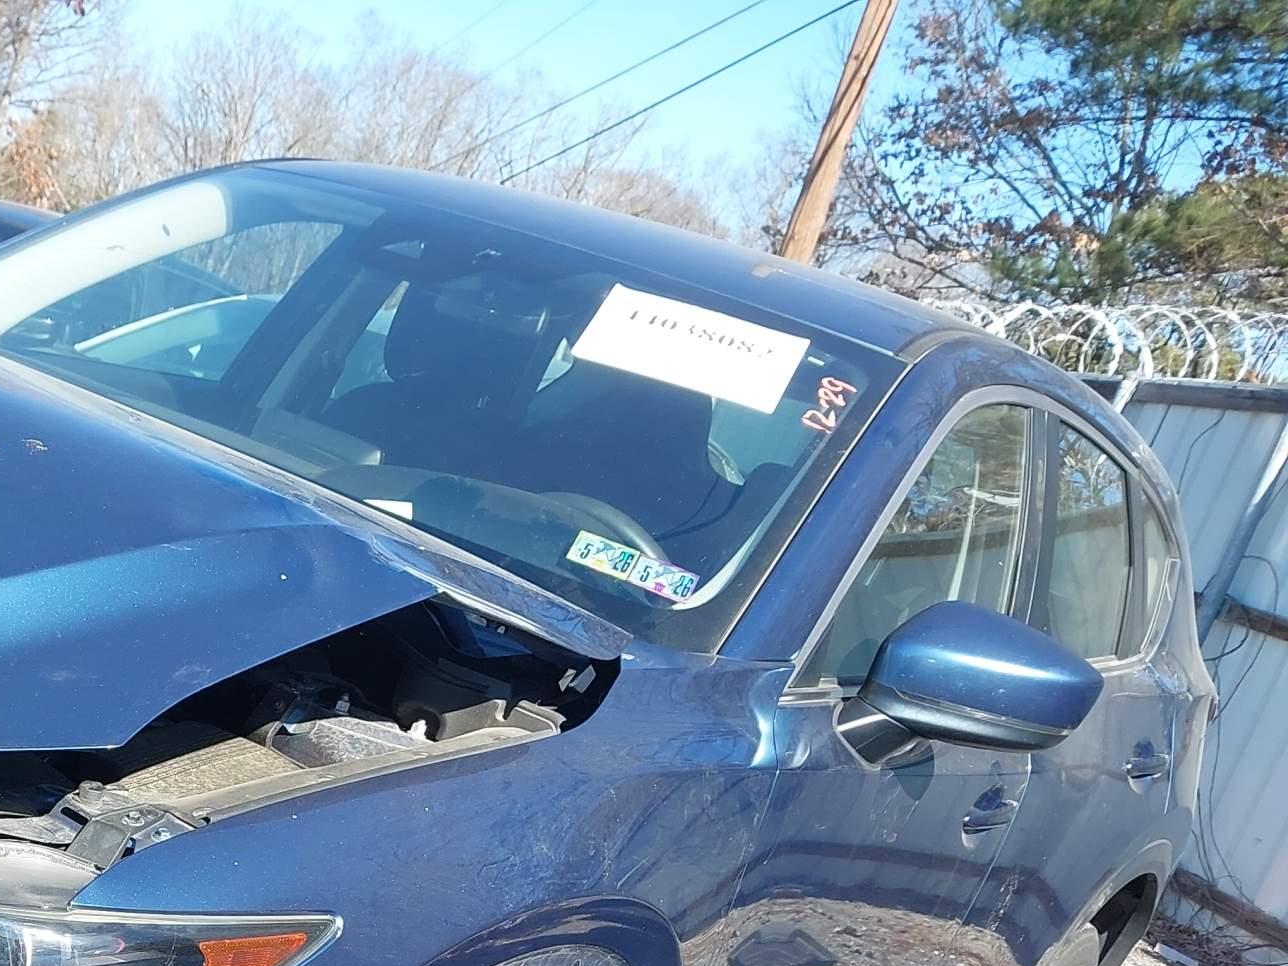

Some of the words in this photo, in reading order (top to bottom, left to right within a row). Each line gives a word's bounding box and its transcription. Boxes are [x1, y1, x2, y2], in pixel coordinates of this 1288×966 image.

[580, 542, 594, 559] 5
[613, 550, 634, 573] 26
[639, 565, 653, 583] 5
[673, 575, 694, 598] 26
